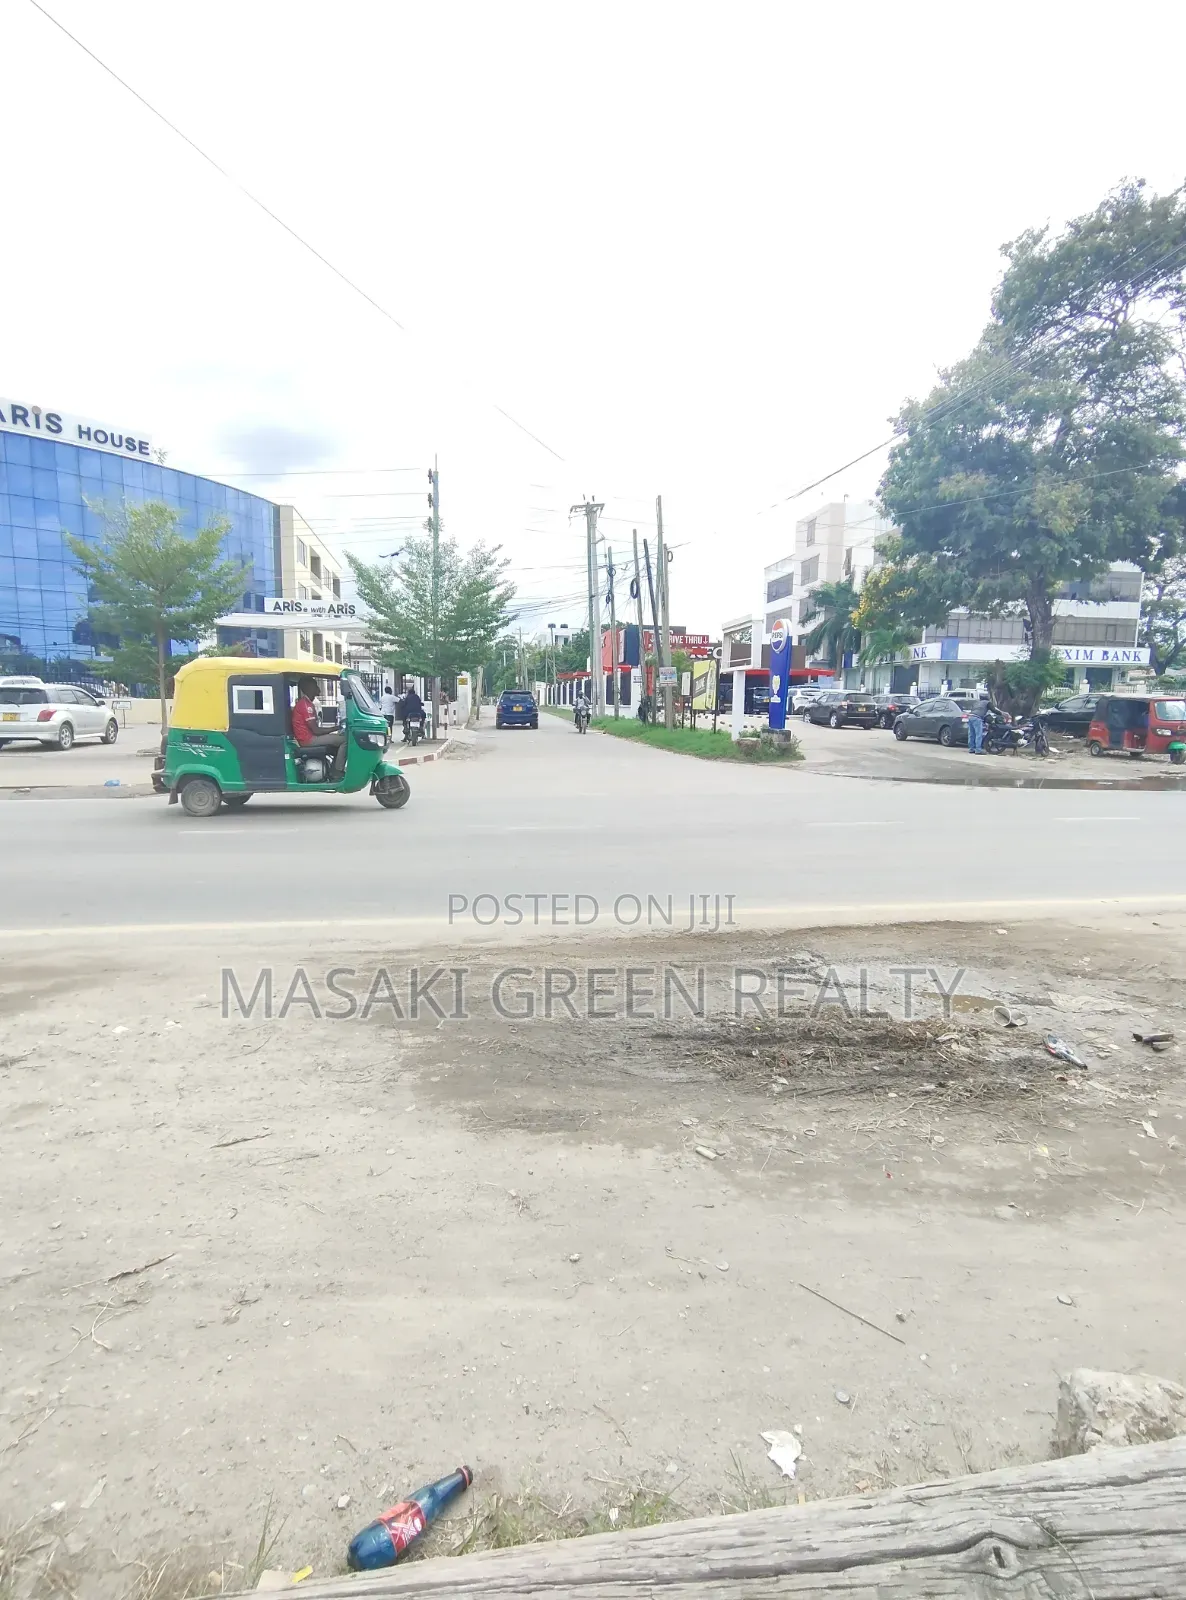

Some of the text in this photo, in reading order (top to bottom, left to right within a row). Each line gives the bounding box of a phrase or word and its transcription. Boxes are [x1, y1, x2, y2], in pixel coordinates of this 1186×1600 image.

[78, 424, 150, 456] HOUSE
[311, 606, 326, 614] with
[660, 635, 703, 645] RIVE THRU
[771, 631, 784, 639] PEPSI
[1063, 649, 1142, 662] XIM BANK
